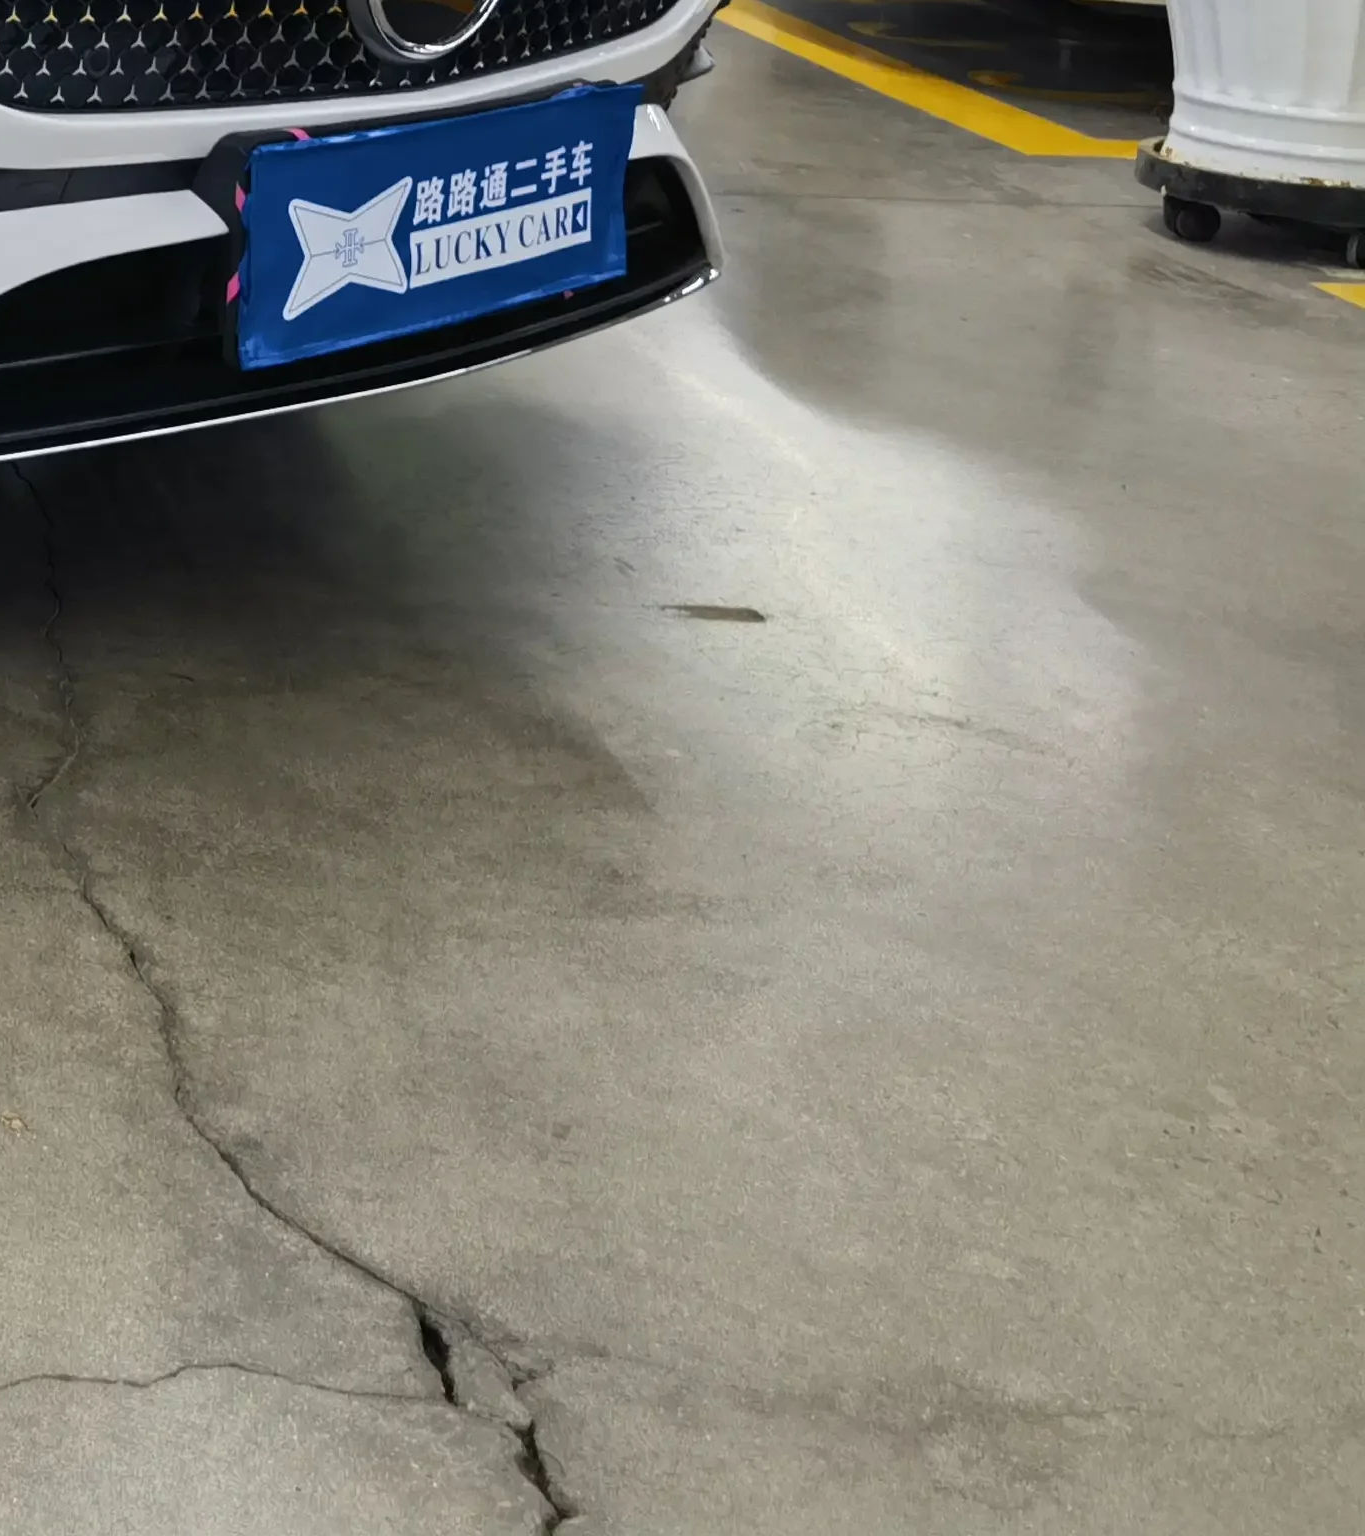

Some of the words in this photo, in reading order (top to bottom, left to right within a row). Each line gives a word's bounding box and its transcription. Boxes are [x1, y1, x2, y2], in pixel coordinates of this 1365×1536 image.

[413, 140, 593, 225] 路路通二手车
[414, 219, 511, 277] LUCKY
[518, 206, 569, 248] CAR
